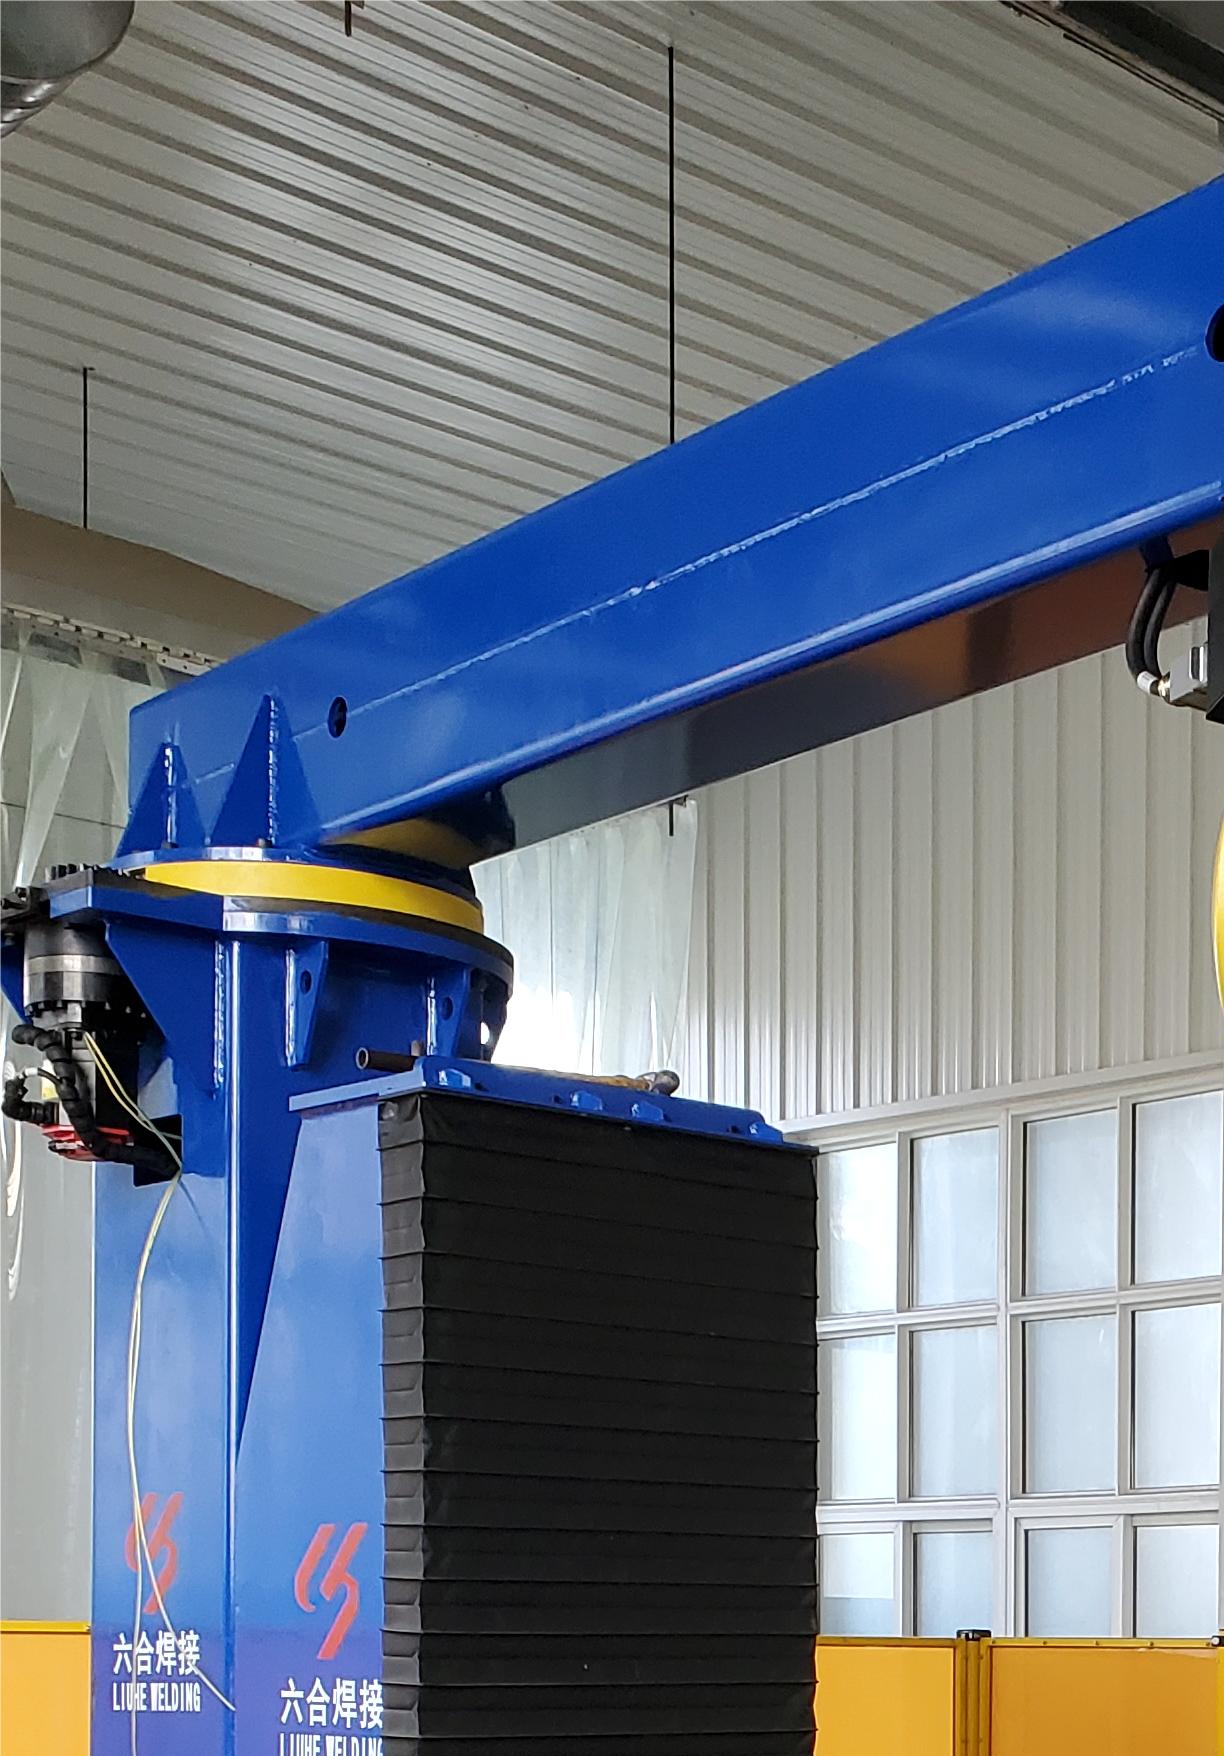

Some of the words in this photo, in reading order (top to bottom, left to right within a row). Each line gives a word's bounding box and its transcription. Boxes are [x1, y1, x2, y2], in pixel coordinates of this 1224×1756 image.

[113, 1630, 200, 1676] 六合焊接
[113, 1682, 148, 1712] LIUHE
[150, 1682, 201, 1712] WELDING
[280, 1677, 384, 1729] 六合焊接
